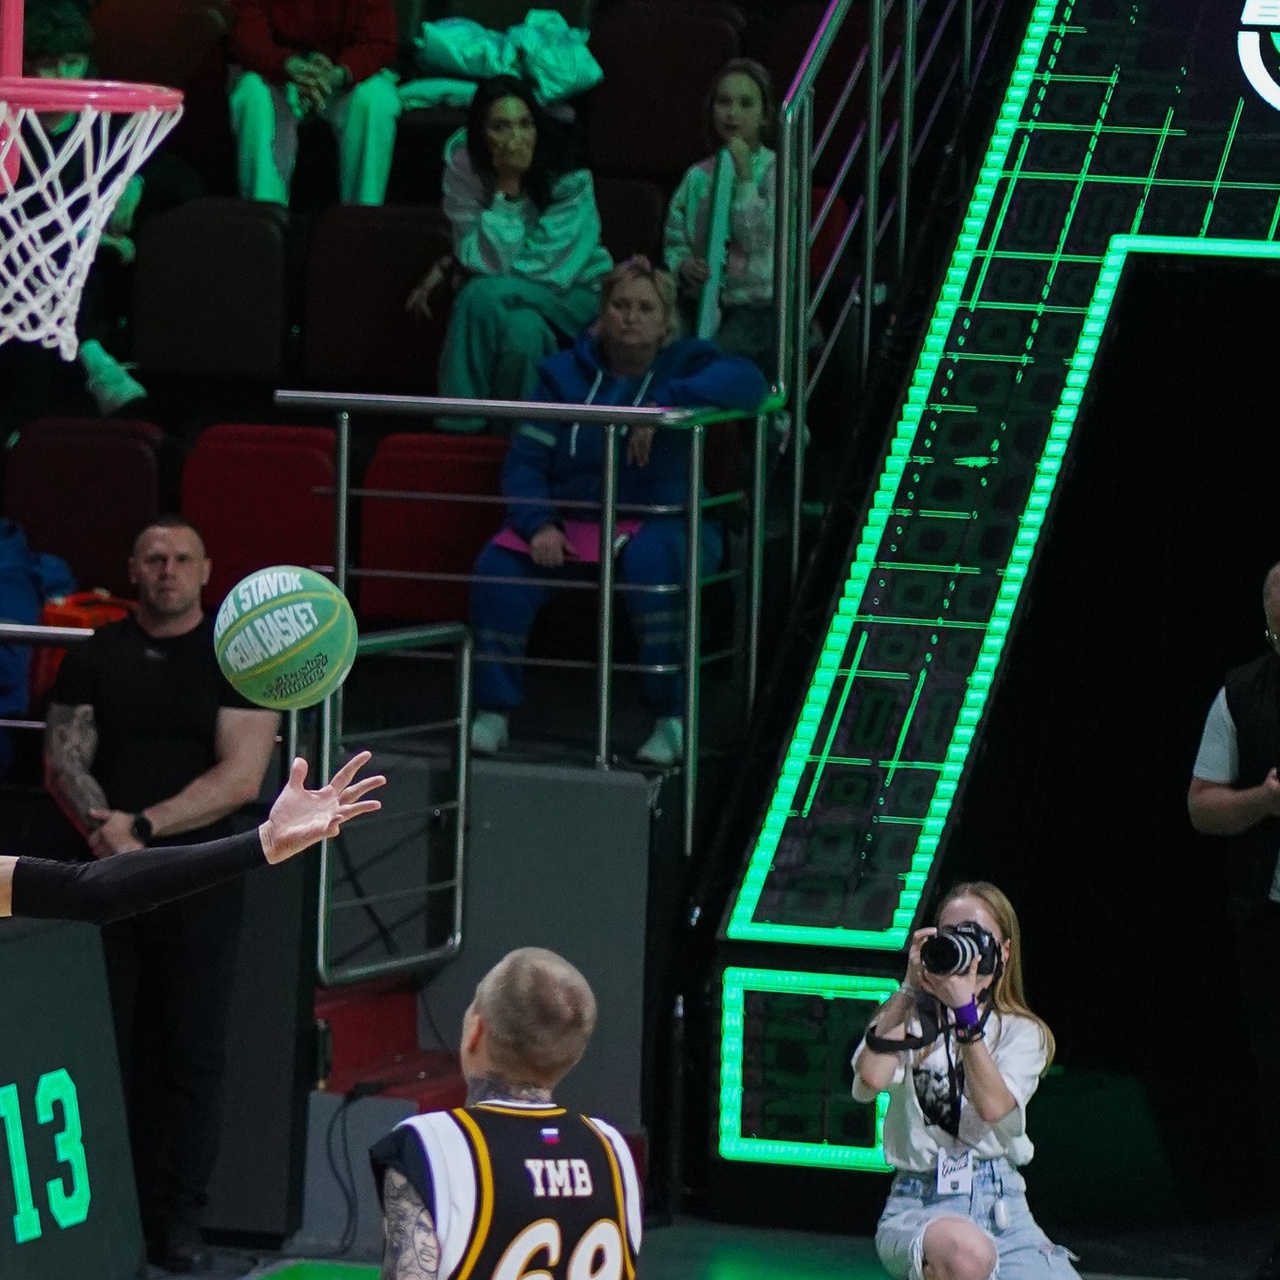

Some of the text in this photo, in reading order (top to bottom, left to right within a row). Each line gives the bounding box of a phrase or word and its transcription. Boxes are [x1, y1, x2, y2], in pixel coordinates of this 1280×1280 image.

[238, 571, 304, 613] STAVOK
[225, 601, 320, 674] MEDIA BASKET
